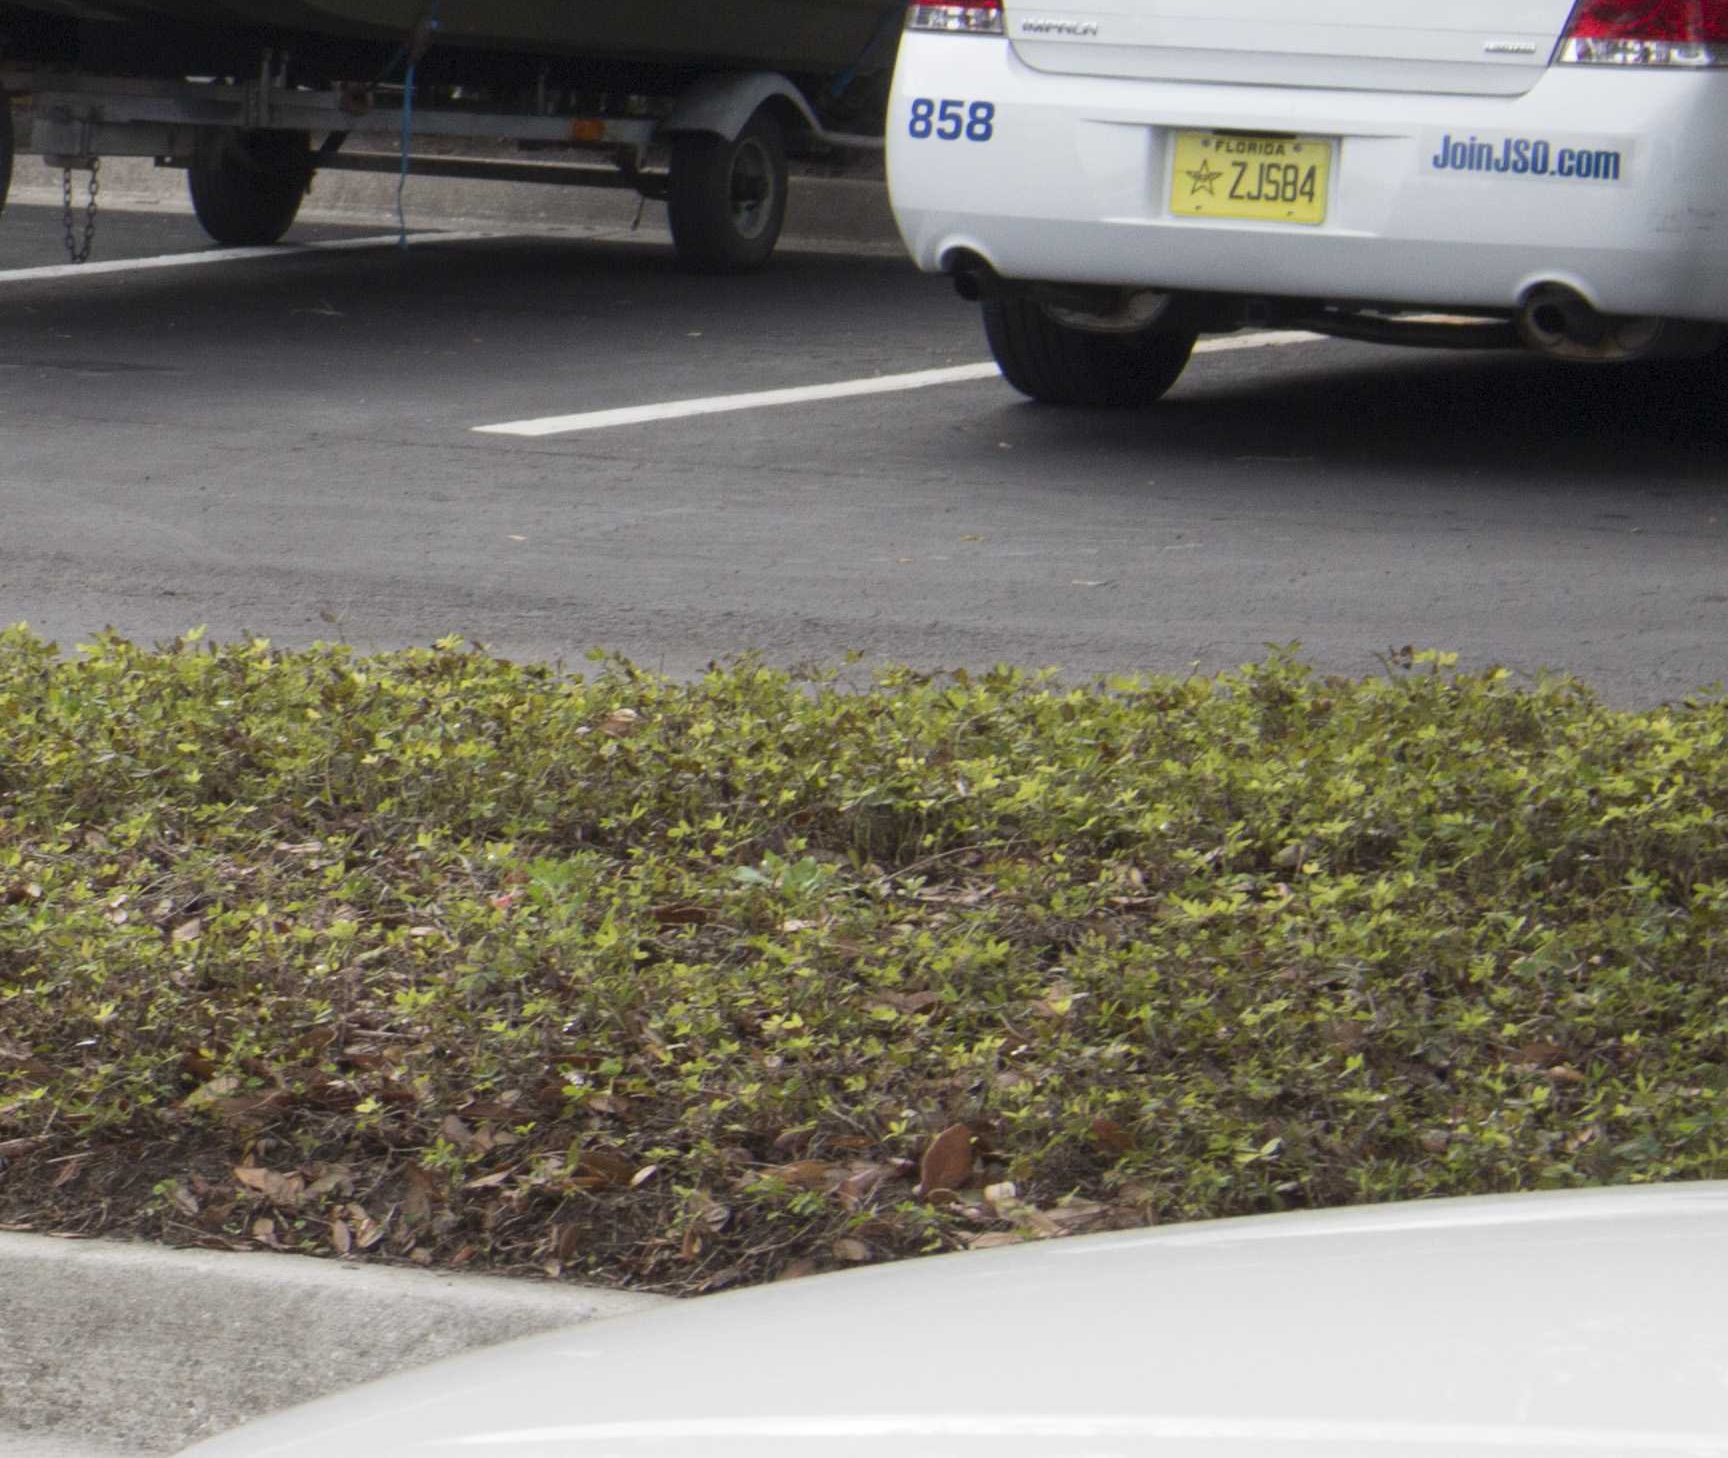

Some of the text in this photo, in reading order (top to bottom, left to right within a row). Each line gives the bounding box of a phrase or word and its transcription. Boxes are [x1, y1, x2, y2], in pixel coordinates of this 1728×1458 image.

[907, 98, 996, 143] 858
[1215, 139, 1286, 156] FLORIDA
[1432, 133, 1621, 182] JoinJSO.com
